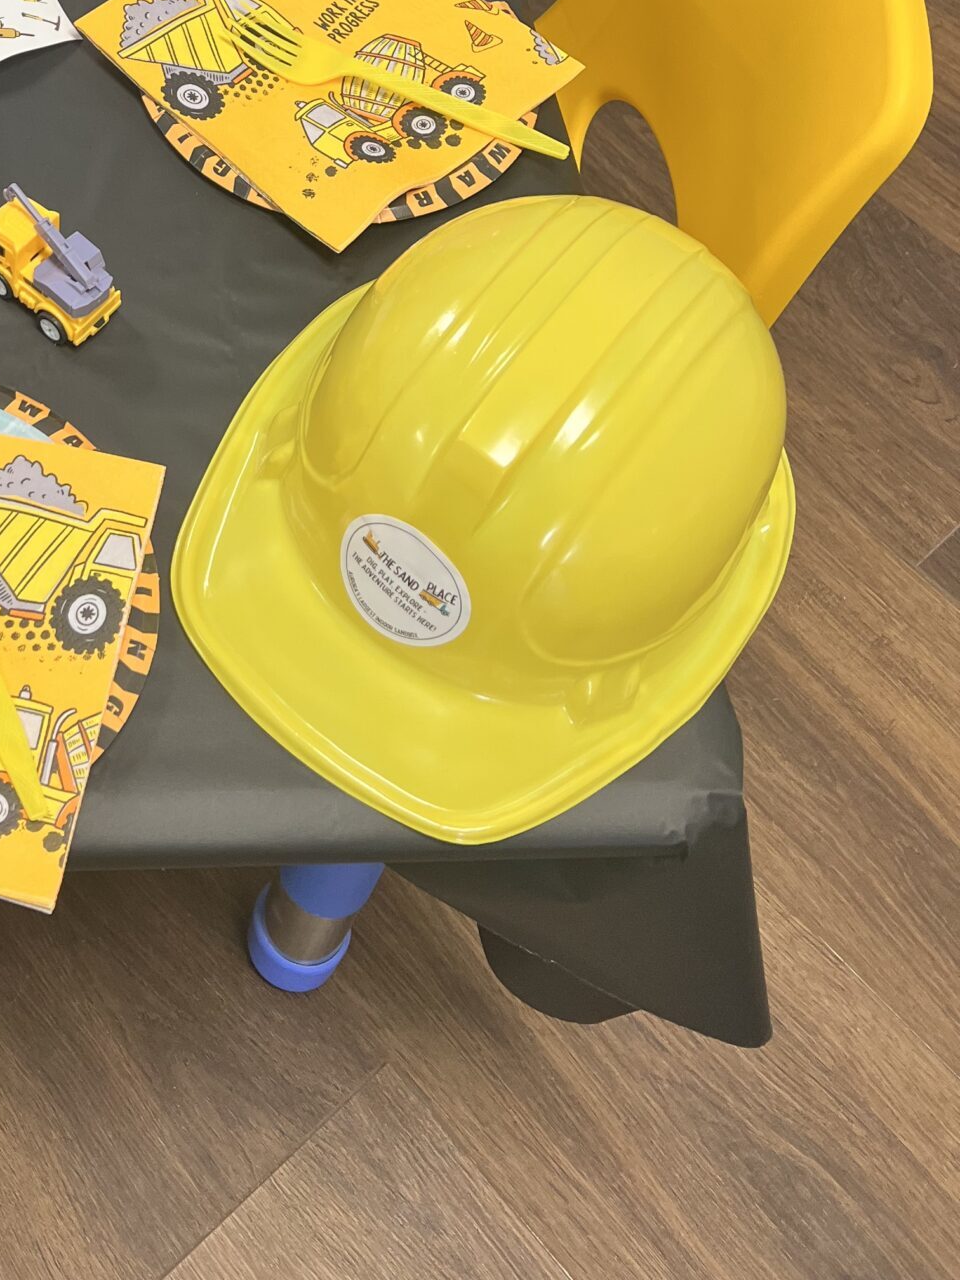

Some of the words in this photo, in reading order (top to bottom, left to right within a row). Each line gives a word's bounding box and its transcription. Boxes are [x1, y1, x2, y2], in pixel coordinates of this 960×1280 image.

[313, 1, 348, 31] WORK
[352, 552, 364, 567] THE
[362, 564, 394, 597] ADVENTURE
[394, 596, 417, 618] STARTS
[417, 616, 437, 631] HERE!
[380, 552, 396, 569] THE
[394, 566, 420, 591] SAND
[427, 582, 457, 605] PLACE
[395, 585, 423, 611] EXPLORE
